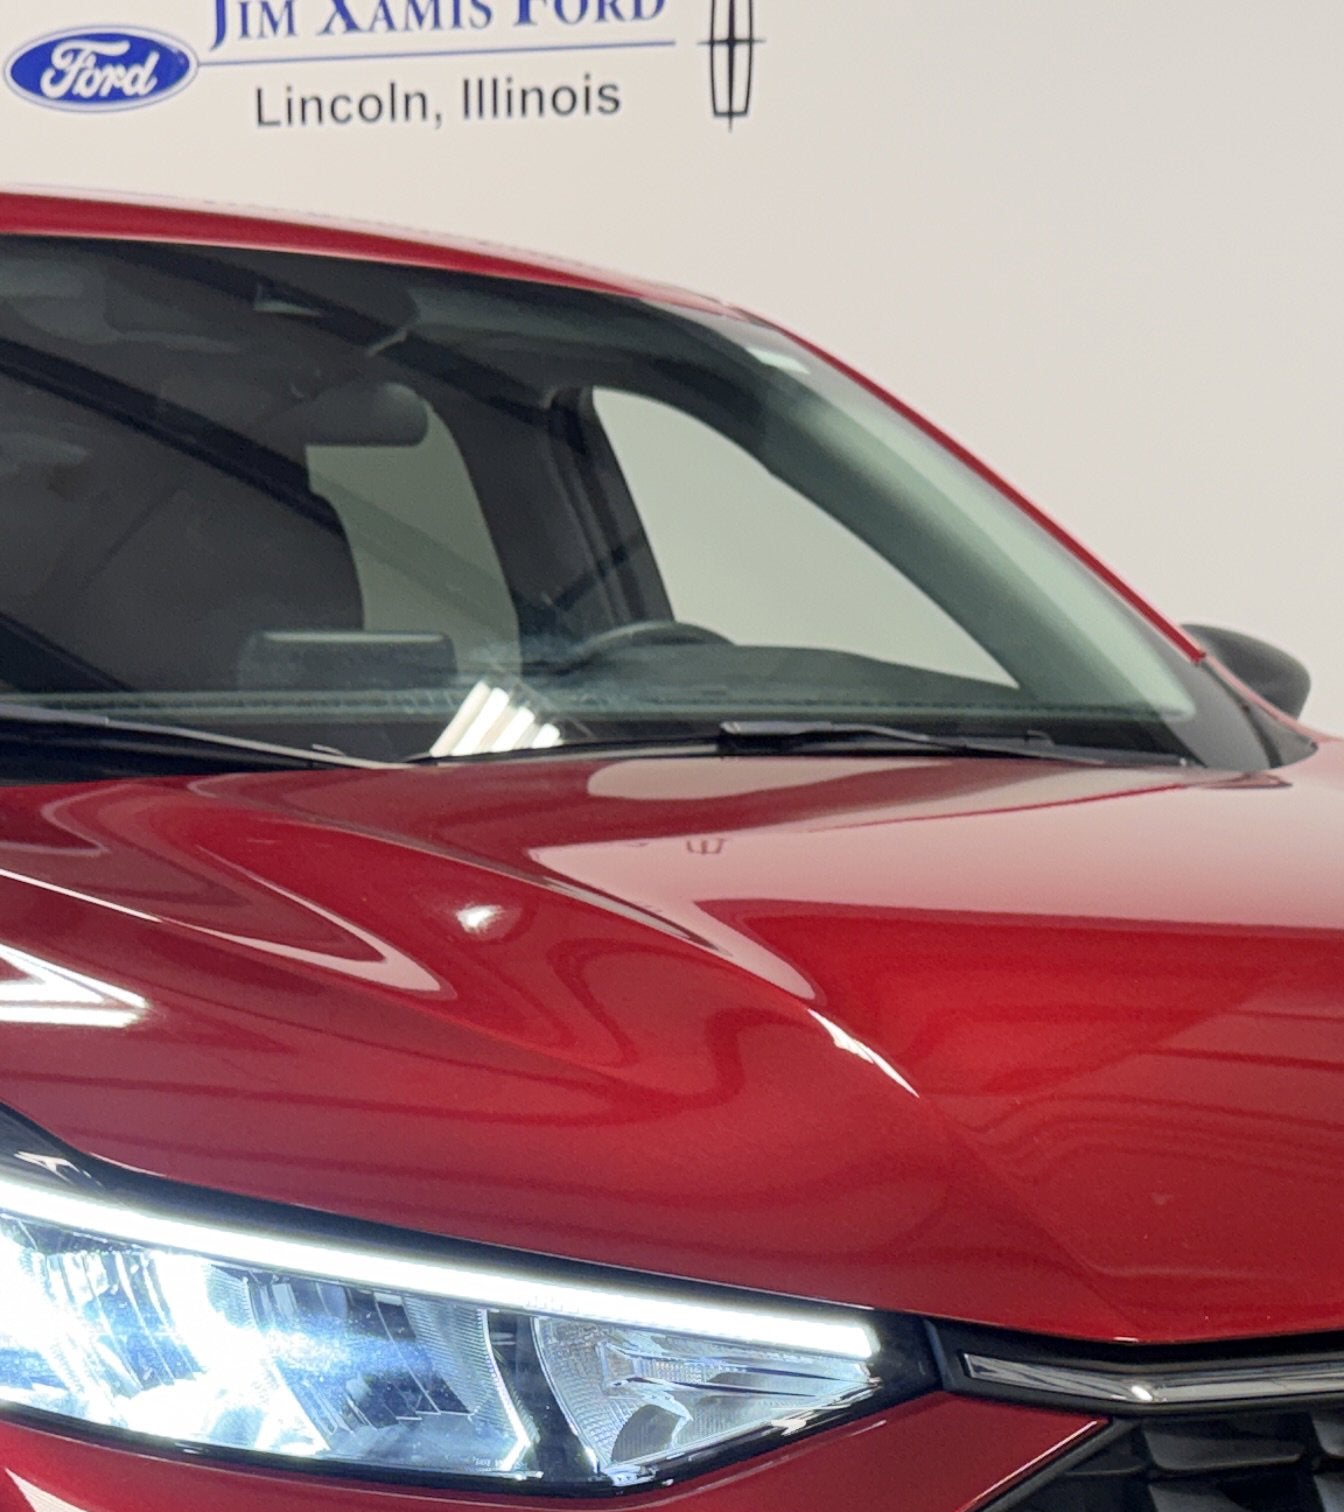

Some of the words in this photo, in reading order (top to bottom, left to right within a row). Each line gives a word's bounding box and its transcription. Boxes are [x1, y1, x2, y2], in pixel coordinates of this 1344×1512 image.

[209, 0, 298, 51] JIM
[39, 40, 160, 99] Ford
[255, 80, 444, 129] Lincoln,
[462, 73, 623, 121] Illinois
